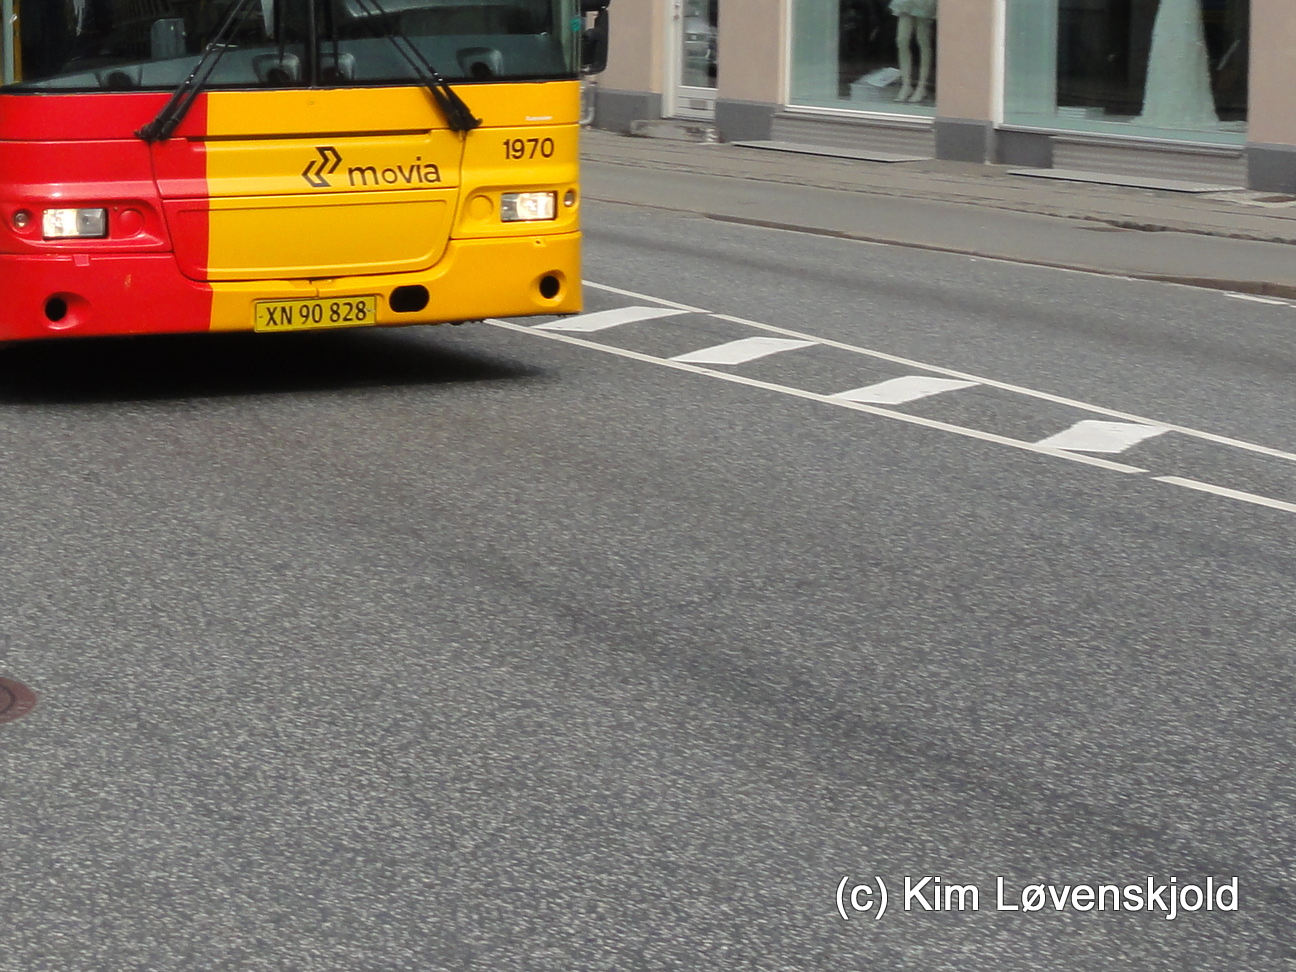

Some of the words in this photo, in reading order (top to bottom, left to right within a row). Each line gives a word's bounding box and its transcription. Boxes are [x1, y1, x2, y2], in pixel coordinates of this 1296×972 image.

[503, 137, 555, 160] 1970
[347, 156, 441, 187] movia
[266, 306, 293, 326] XN
[299, 303, 323, 324] 90
[329, 301, 367, 322] 828
